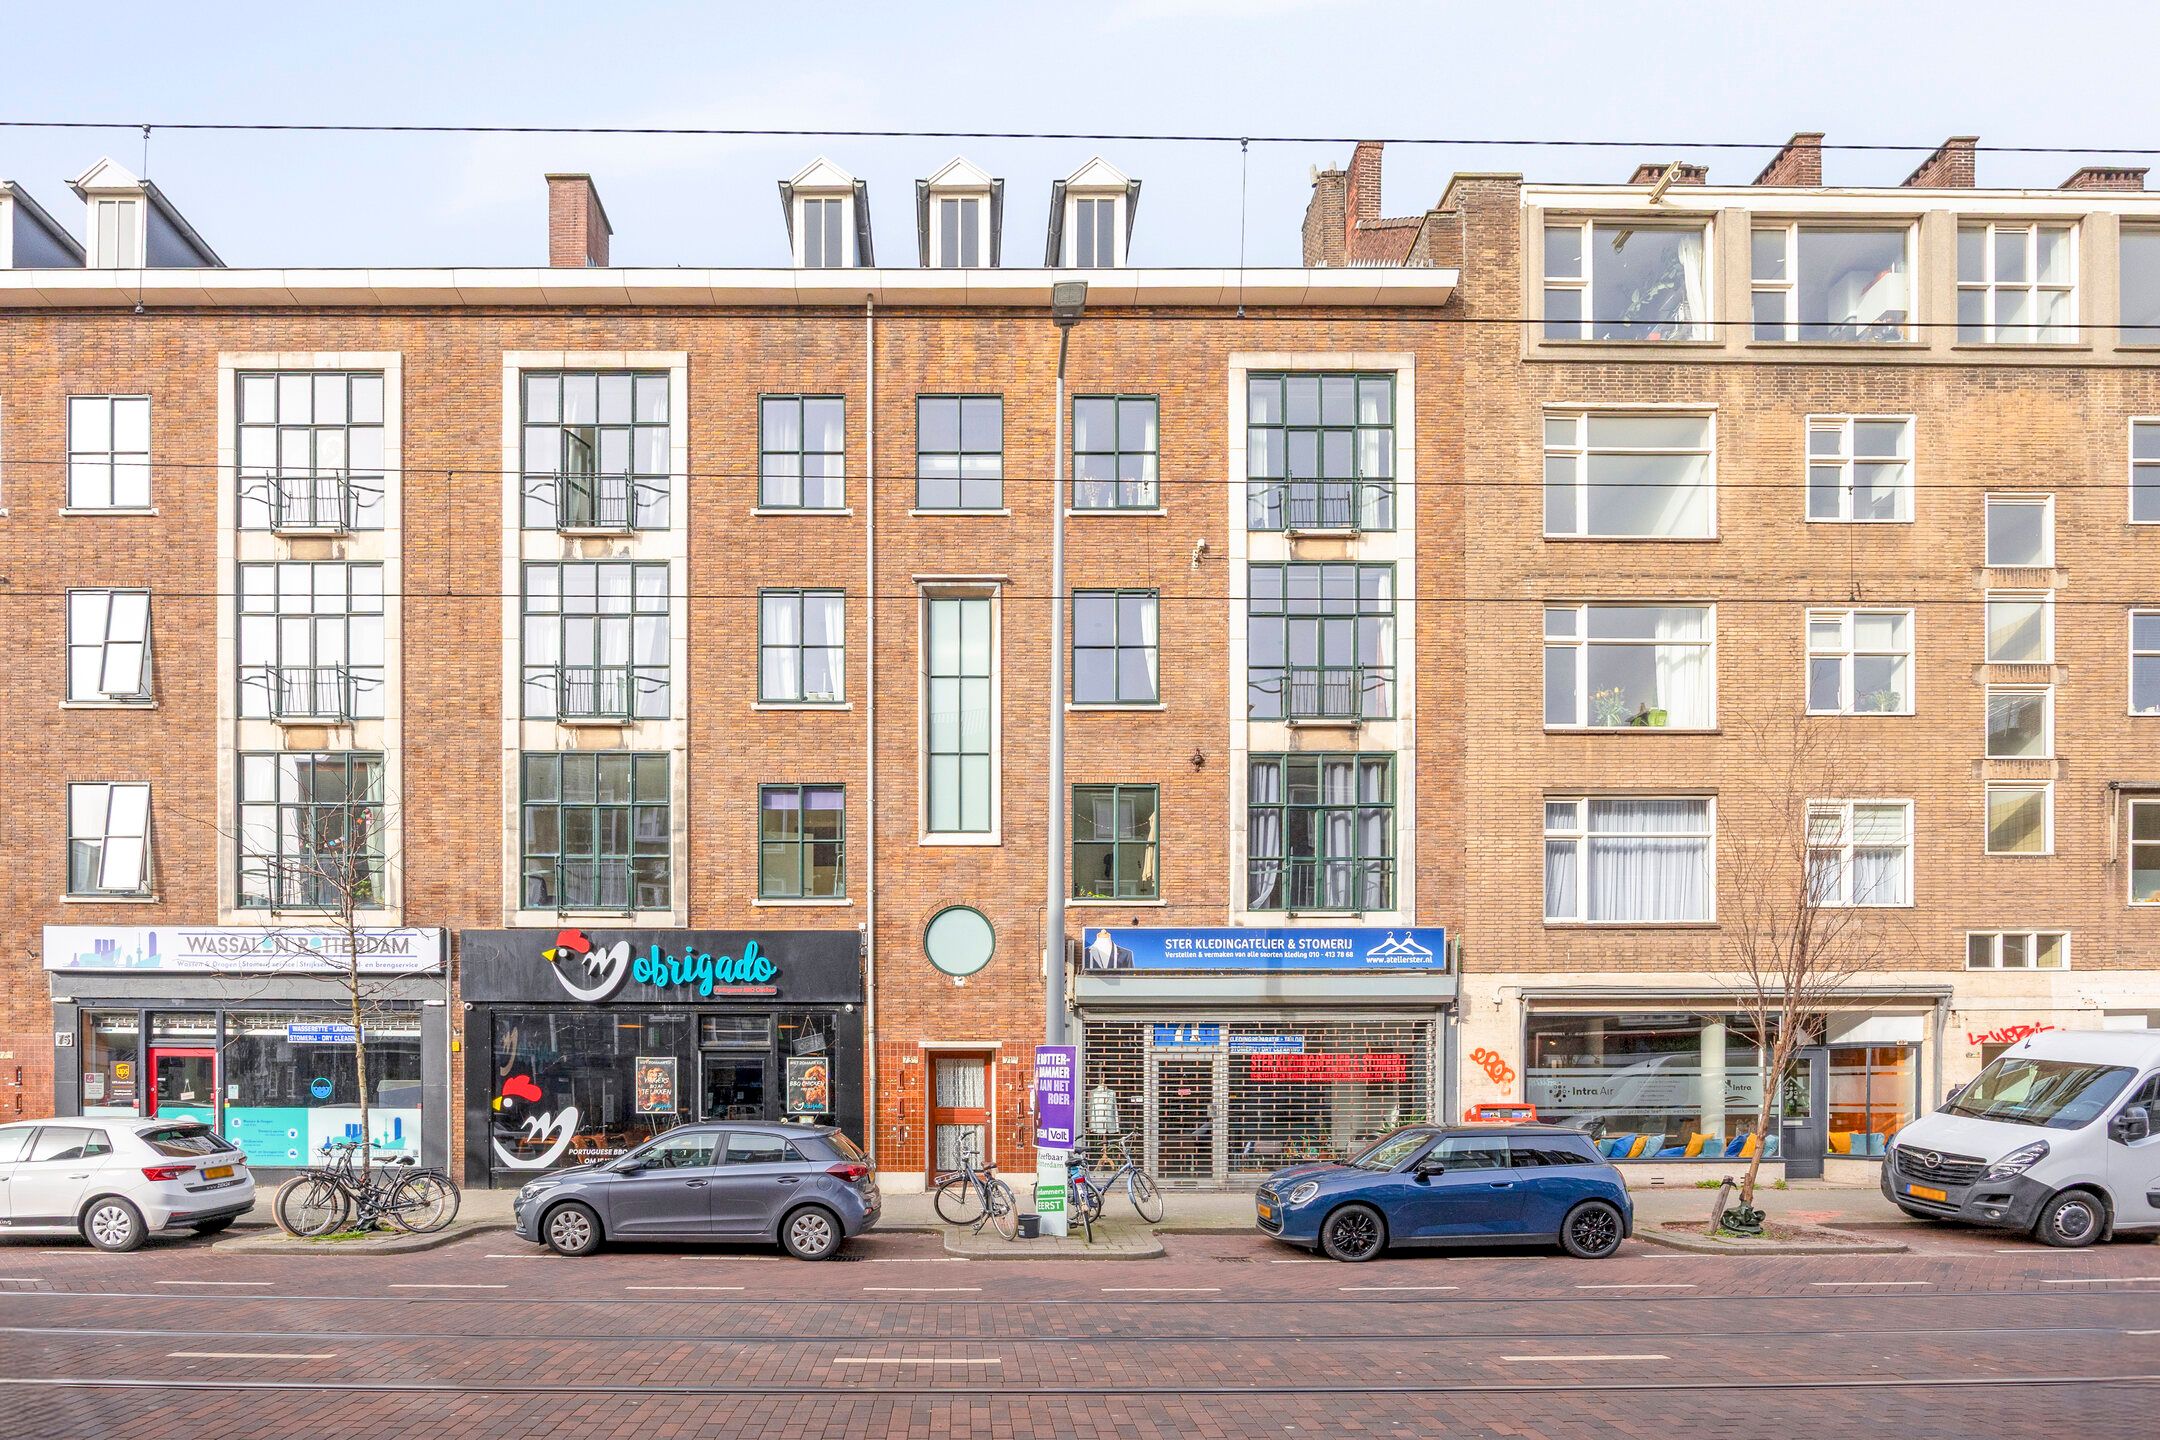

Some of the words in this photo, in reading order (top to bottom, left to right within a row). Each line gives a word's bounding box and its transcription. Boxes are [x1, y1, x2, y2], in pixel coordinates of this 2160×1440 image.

[298, 936, 409, 954] ROTTERDAM
[1165, 938, 1193, 949] STER
[1196, 938, 1285, 949] KLEDINGATELIER
[1288, 938, 1296, 949] &
[1299, 938, 1353, 949] STOMERIJ
[1284, 951, 1308, 959] kleding
[376, 960, 419, 969] brengservice
[633, 939, 777, 996] obrigado
[1053, 1080, 1070, 1092] HET
[1733, 1083, 1752, 1091] Intra
[1572, 1087, 1598, 1096] Intra
[1600, 1087, 1615, 1096] Air
[1048, 1093, 1070, 1105] ROER
[1050, 1131, 1067, 1140] Volt
[1038, 1201, 1061, 1210] EERST
